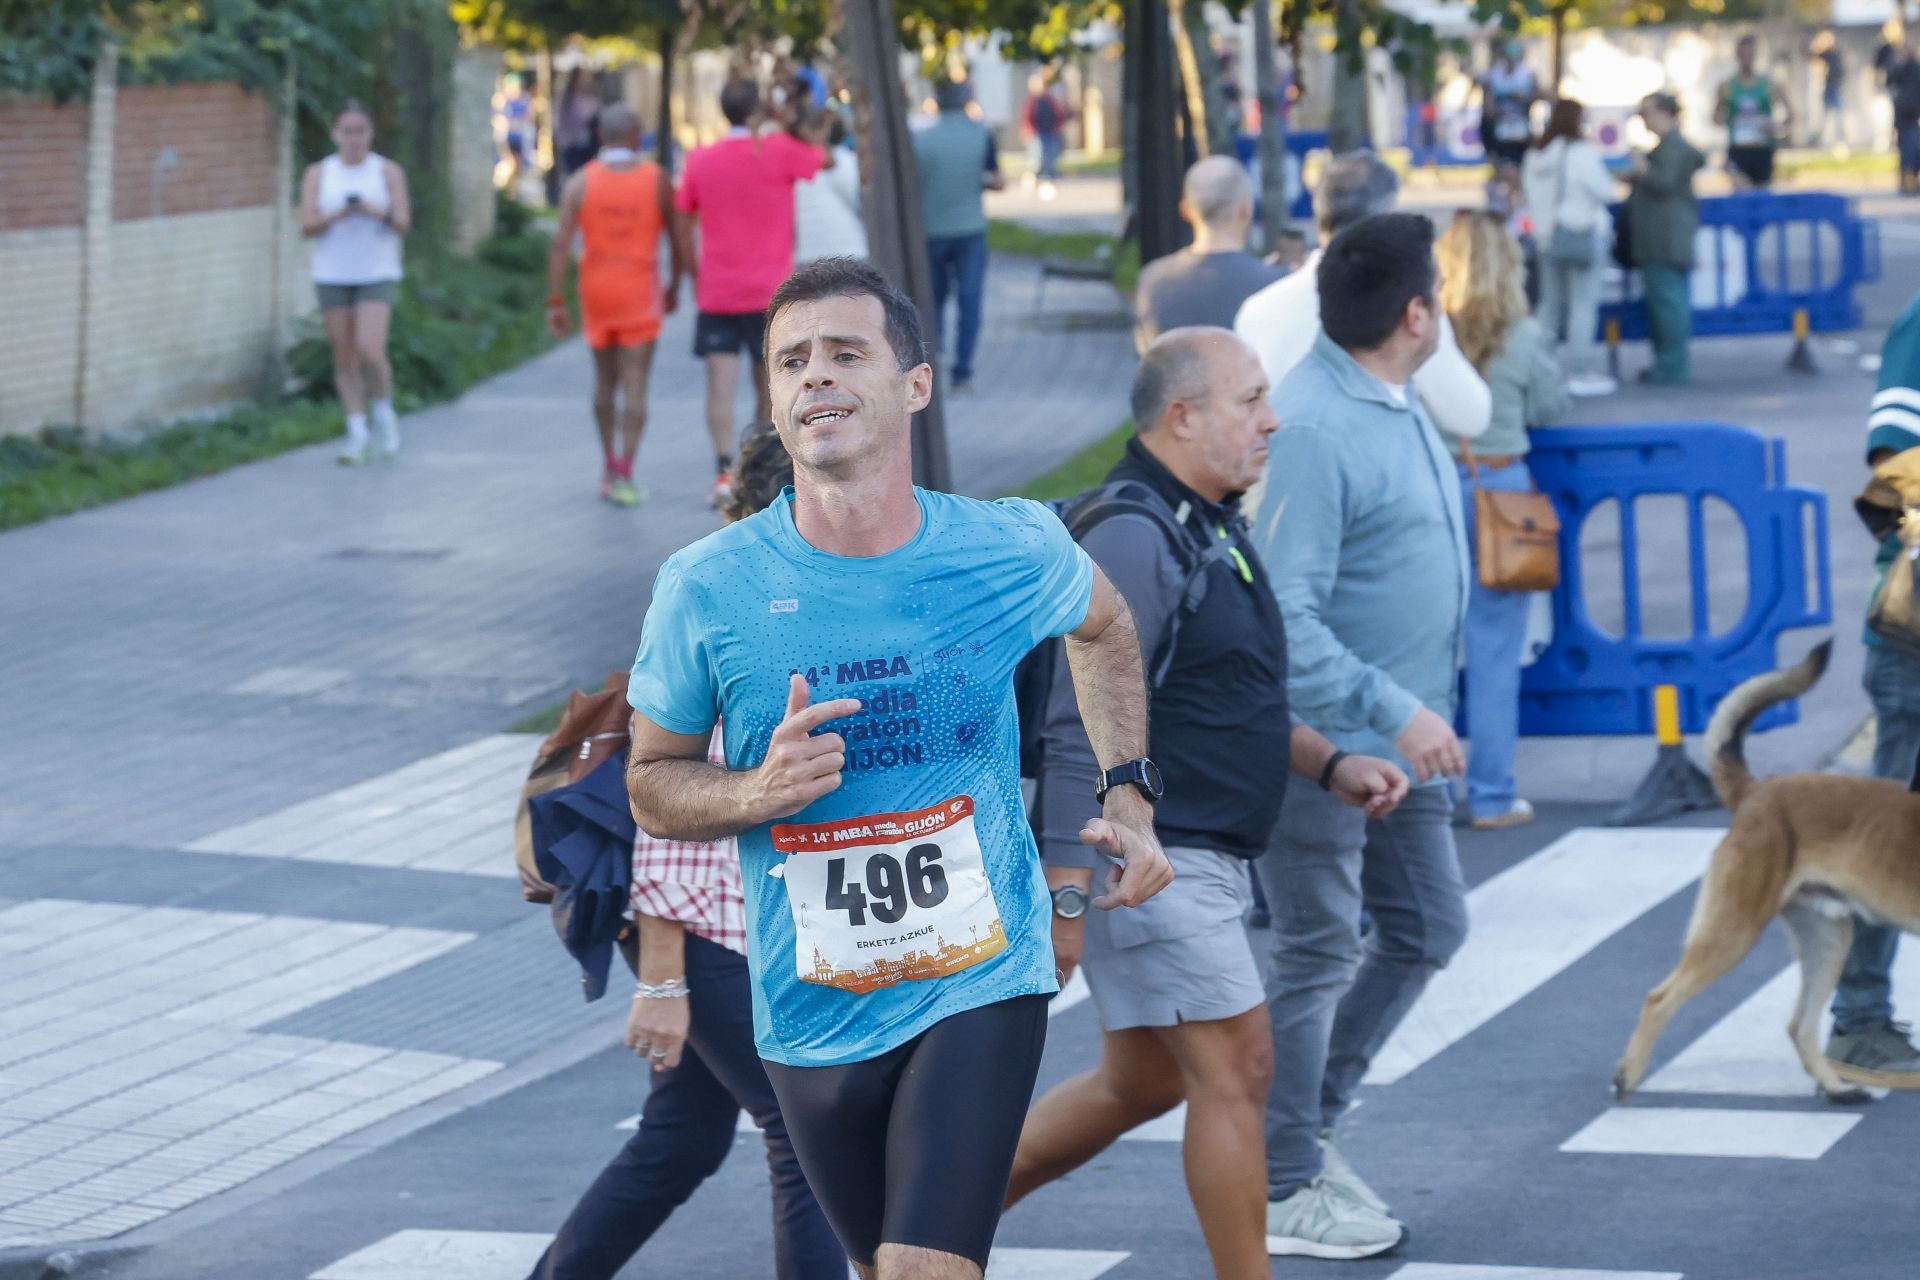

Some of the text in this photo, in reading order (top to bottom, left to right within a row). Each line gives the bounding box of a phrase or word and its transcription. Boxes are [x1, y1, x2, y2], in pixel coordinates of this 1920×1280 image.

[836, 656, 912, 684] MBA
[857, 688, 917, 716] edia
[839, 740, 922, 772] IJÓN
[833, 826, 874, 842] MBA
[874, 821, 897, 831] media
[904, 811, 946, 834] GIJÓN
[825, 842, 949, 927] 496
[856, 924, 935, 949] ERKETZ AZKUE
